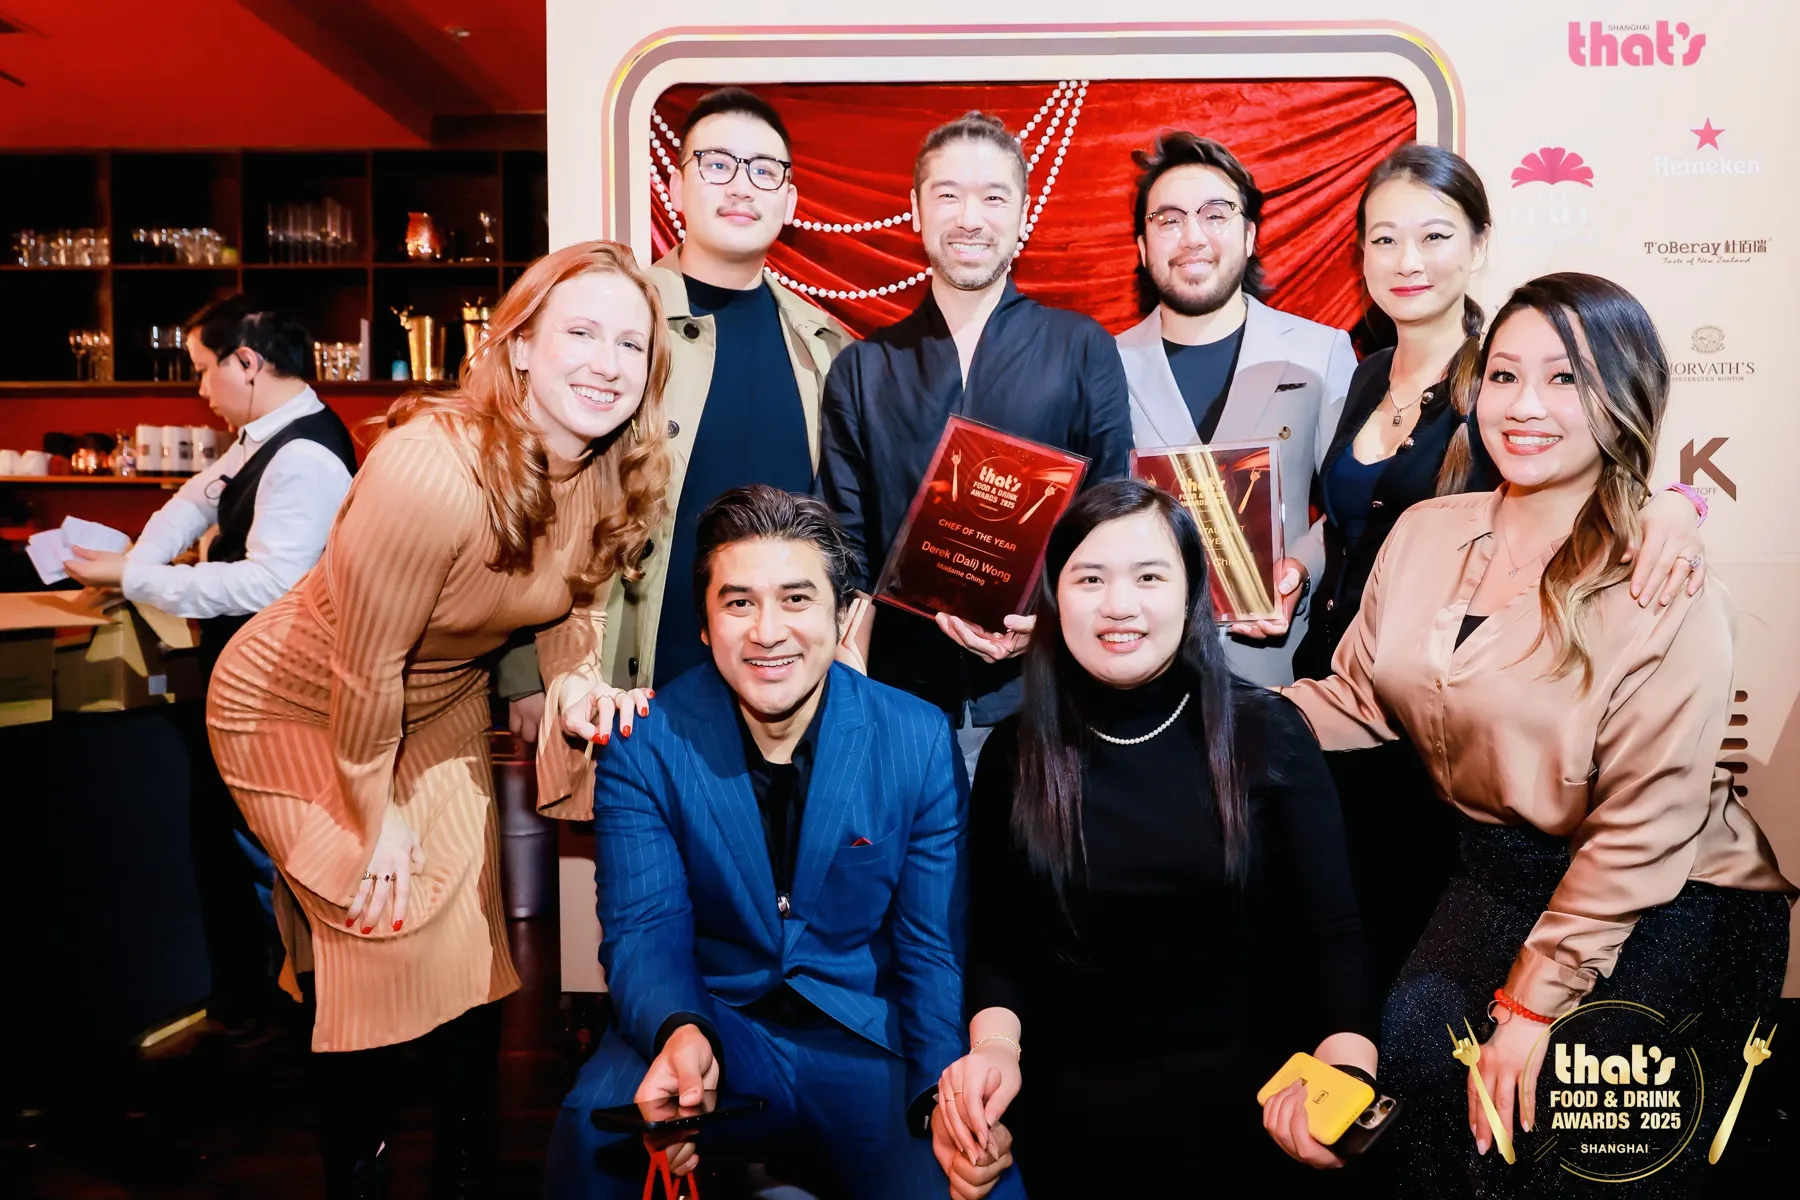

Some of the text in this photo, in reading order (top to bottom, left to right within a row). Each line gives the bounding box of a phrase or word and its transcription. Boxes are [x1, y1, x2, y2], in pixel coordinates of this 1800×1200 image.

[1568, 20, 1706, 67] that's
[1654, 156, 1761, 176] Heineken
[1686, 258, 1694, 266] of
[979, 466, 1022, 491] that's
[970, 489, 1015, 509] AWARDS 2025
[973, 480, 991, 492] FOOD
[997, 490, 1018, 502] DRINK
[938, 518, 1017, 552] CHEF OF THE YEAR
[921, 540, 1011, 582] Derek (Dali) Wong
[936, 562, 985, 586] Madame Ching
